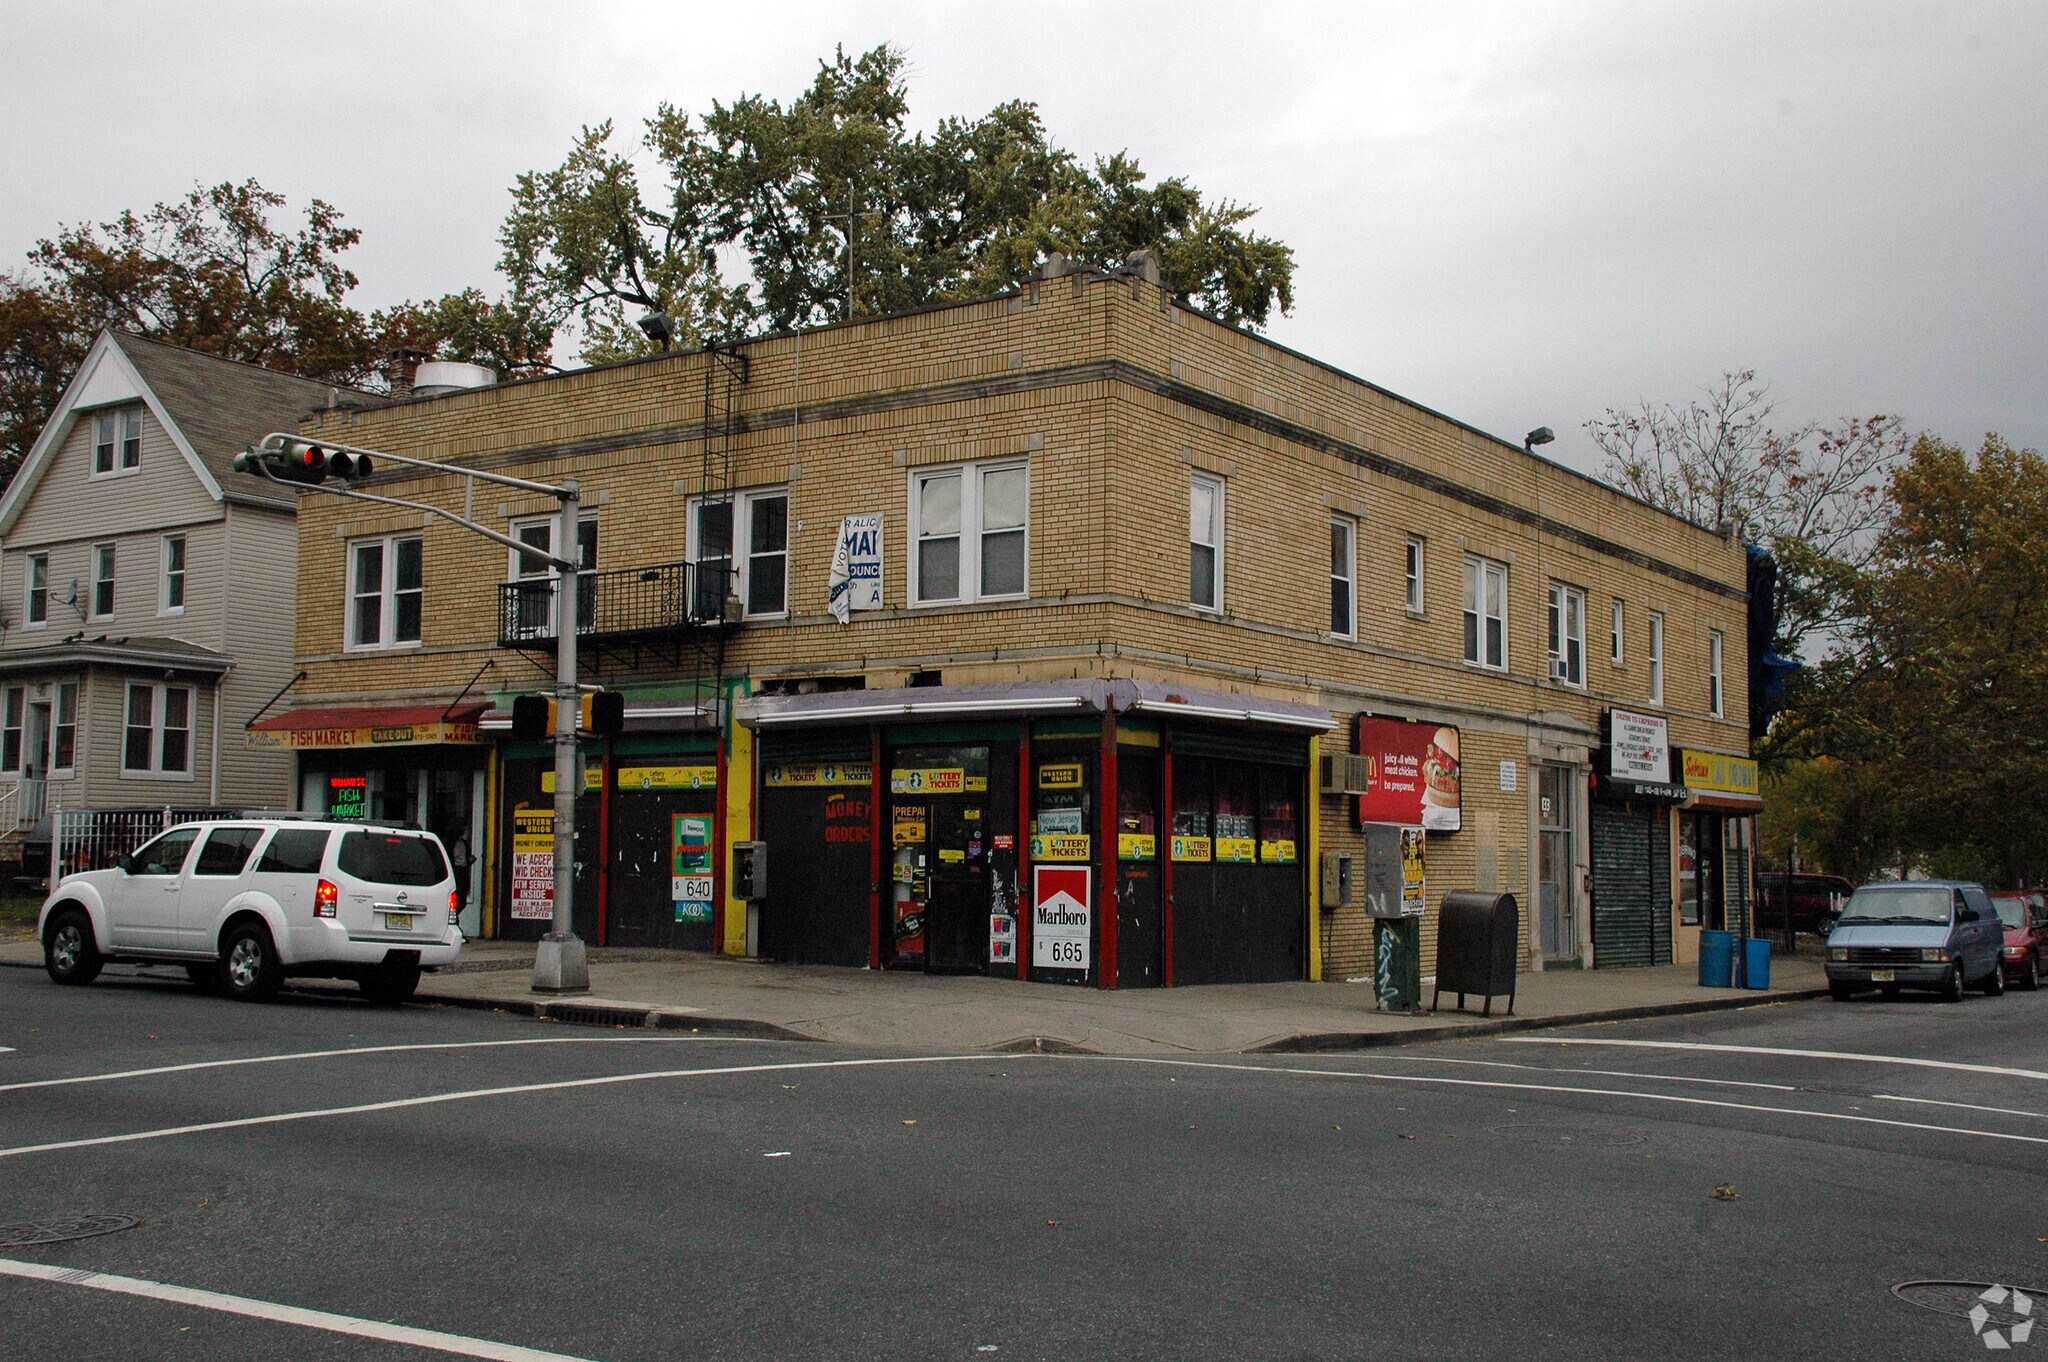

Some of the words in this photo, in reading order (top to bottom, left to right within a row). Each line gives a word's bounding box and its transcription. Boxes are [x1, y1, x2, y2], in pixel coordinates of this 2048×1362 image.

[291, 731, 313, 746] FISH
[315, 730, 356, 746] MARKET
[788, 766, 817, 774] LOTTERY
[1385, 766, 1398, 775] meat
[789, 773, 817, 781] TICKETS
[929, 772, 962, 781] LOTTERY
[931, 780, 960, 789] TICKETS
[1384, 780, 1391, 790] be
[516, 818, 551, 826] WESTERN
[1040, 815, 1056, 824] New
[526, 825, 551, 833] UNION
[825, 826, 871, 843] ORDERS
[1050, 839, 1089, 848] LOTTERY
[1187, 840, 1209, 849] LOTTERY
[1051, 848, 1087, 857] TICKETS
[1187, 849, 1209, 857] TICKETS
[516, 854, 526, 865] WE
[515, 866, 528, 877] WIC
[530, 866, 553, 878] CHECK
[515, 880, 528, 889] ATM
[675, 882, 679, 890] $
[520, 890, 546, 899] INSIDE
[683, 903, 706, 917] KOOL
[1037, 903, 1087, 925] Marlboro
[1039, 941, 1043, 950] $
[1053, 942, 1083, 962] 6.65
